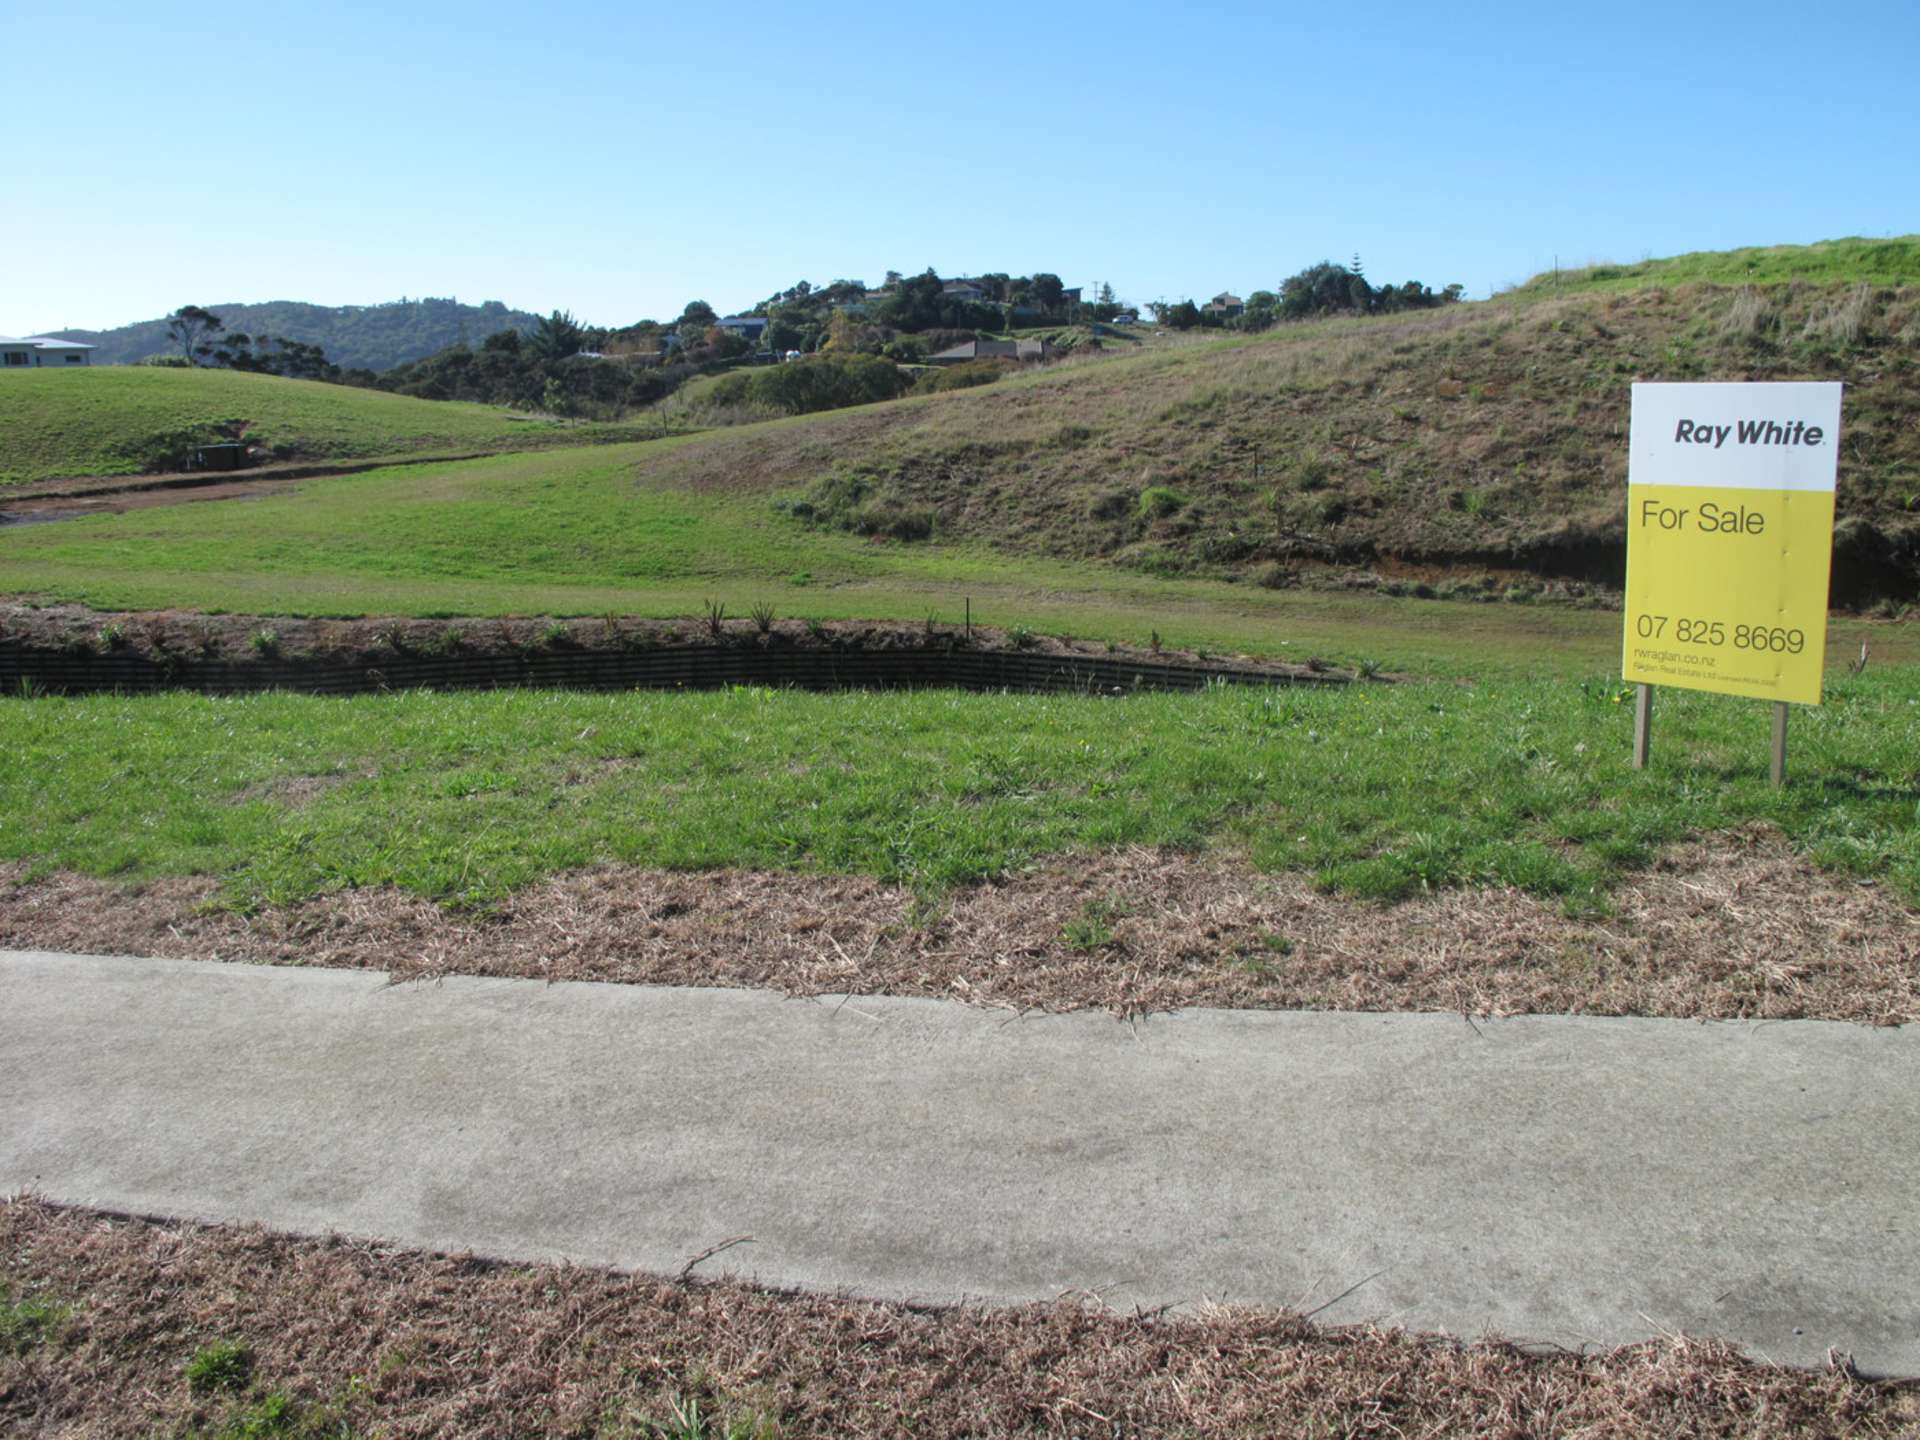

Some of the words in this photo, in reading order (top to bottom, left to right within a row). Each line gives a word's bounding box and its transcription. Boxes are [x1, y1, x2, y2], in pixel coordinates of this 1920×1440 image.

[1675, 419, 1731, 449] Ray
[1641, 500, 1689, 530] For
[1697, 503, 1764, 535] Sale
[1637, 614, 1668, 640] 07
[1676, 618, 1725, 646] 825
[1734, 624, 1804, 654] 8669
